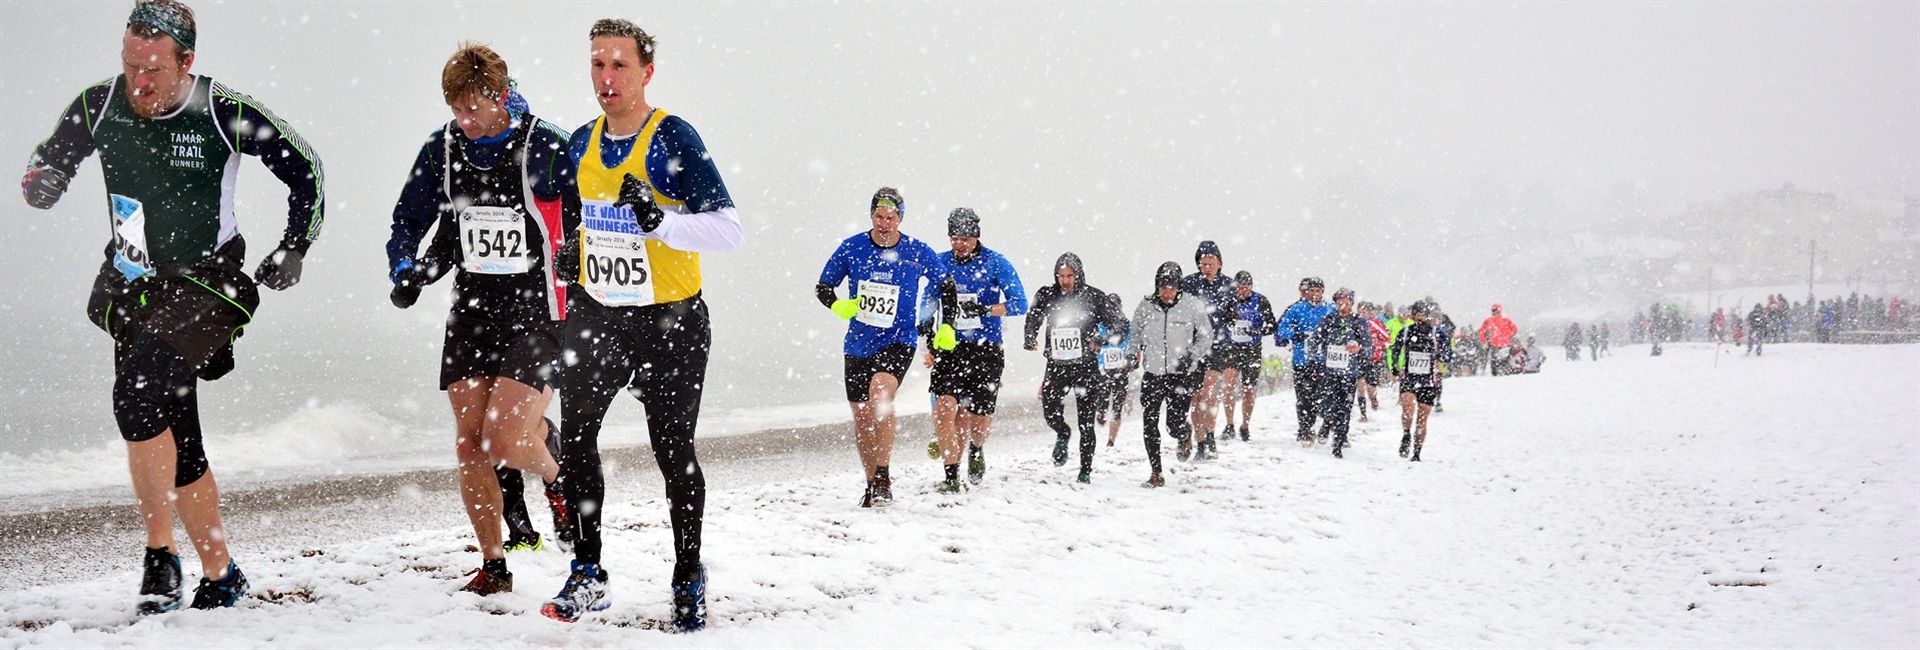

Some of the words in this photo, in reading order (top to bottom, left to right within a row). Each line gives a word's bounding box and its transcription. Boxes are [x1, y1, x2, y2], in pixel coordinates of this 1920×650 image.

[170, 132, 203, 144] TAMAR
[171, 145, 205, 158] TRAIL
[169, 160, 206, 169] RUNNERS
[583, 204, 597, 218] XE
[600, 206, 636, 219] VALLE
[468, 228, 522, 258] 1542
[586, 253, 648, 287] 0905
[859, 294, 895, 316] 0932
[1054, 336, 1080, 351] 1402
